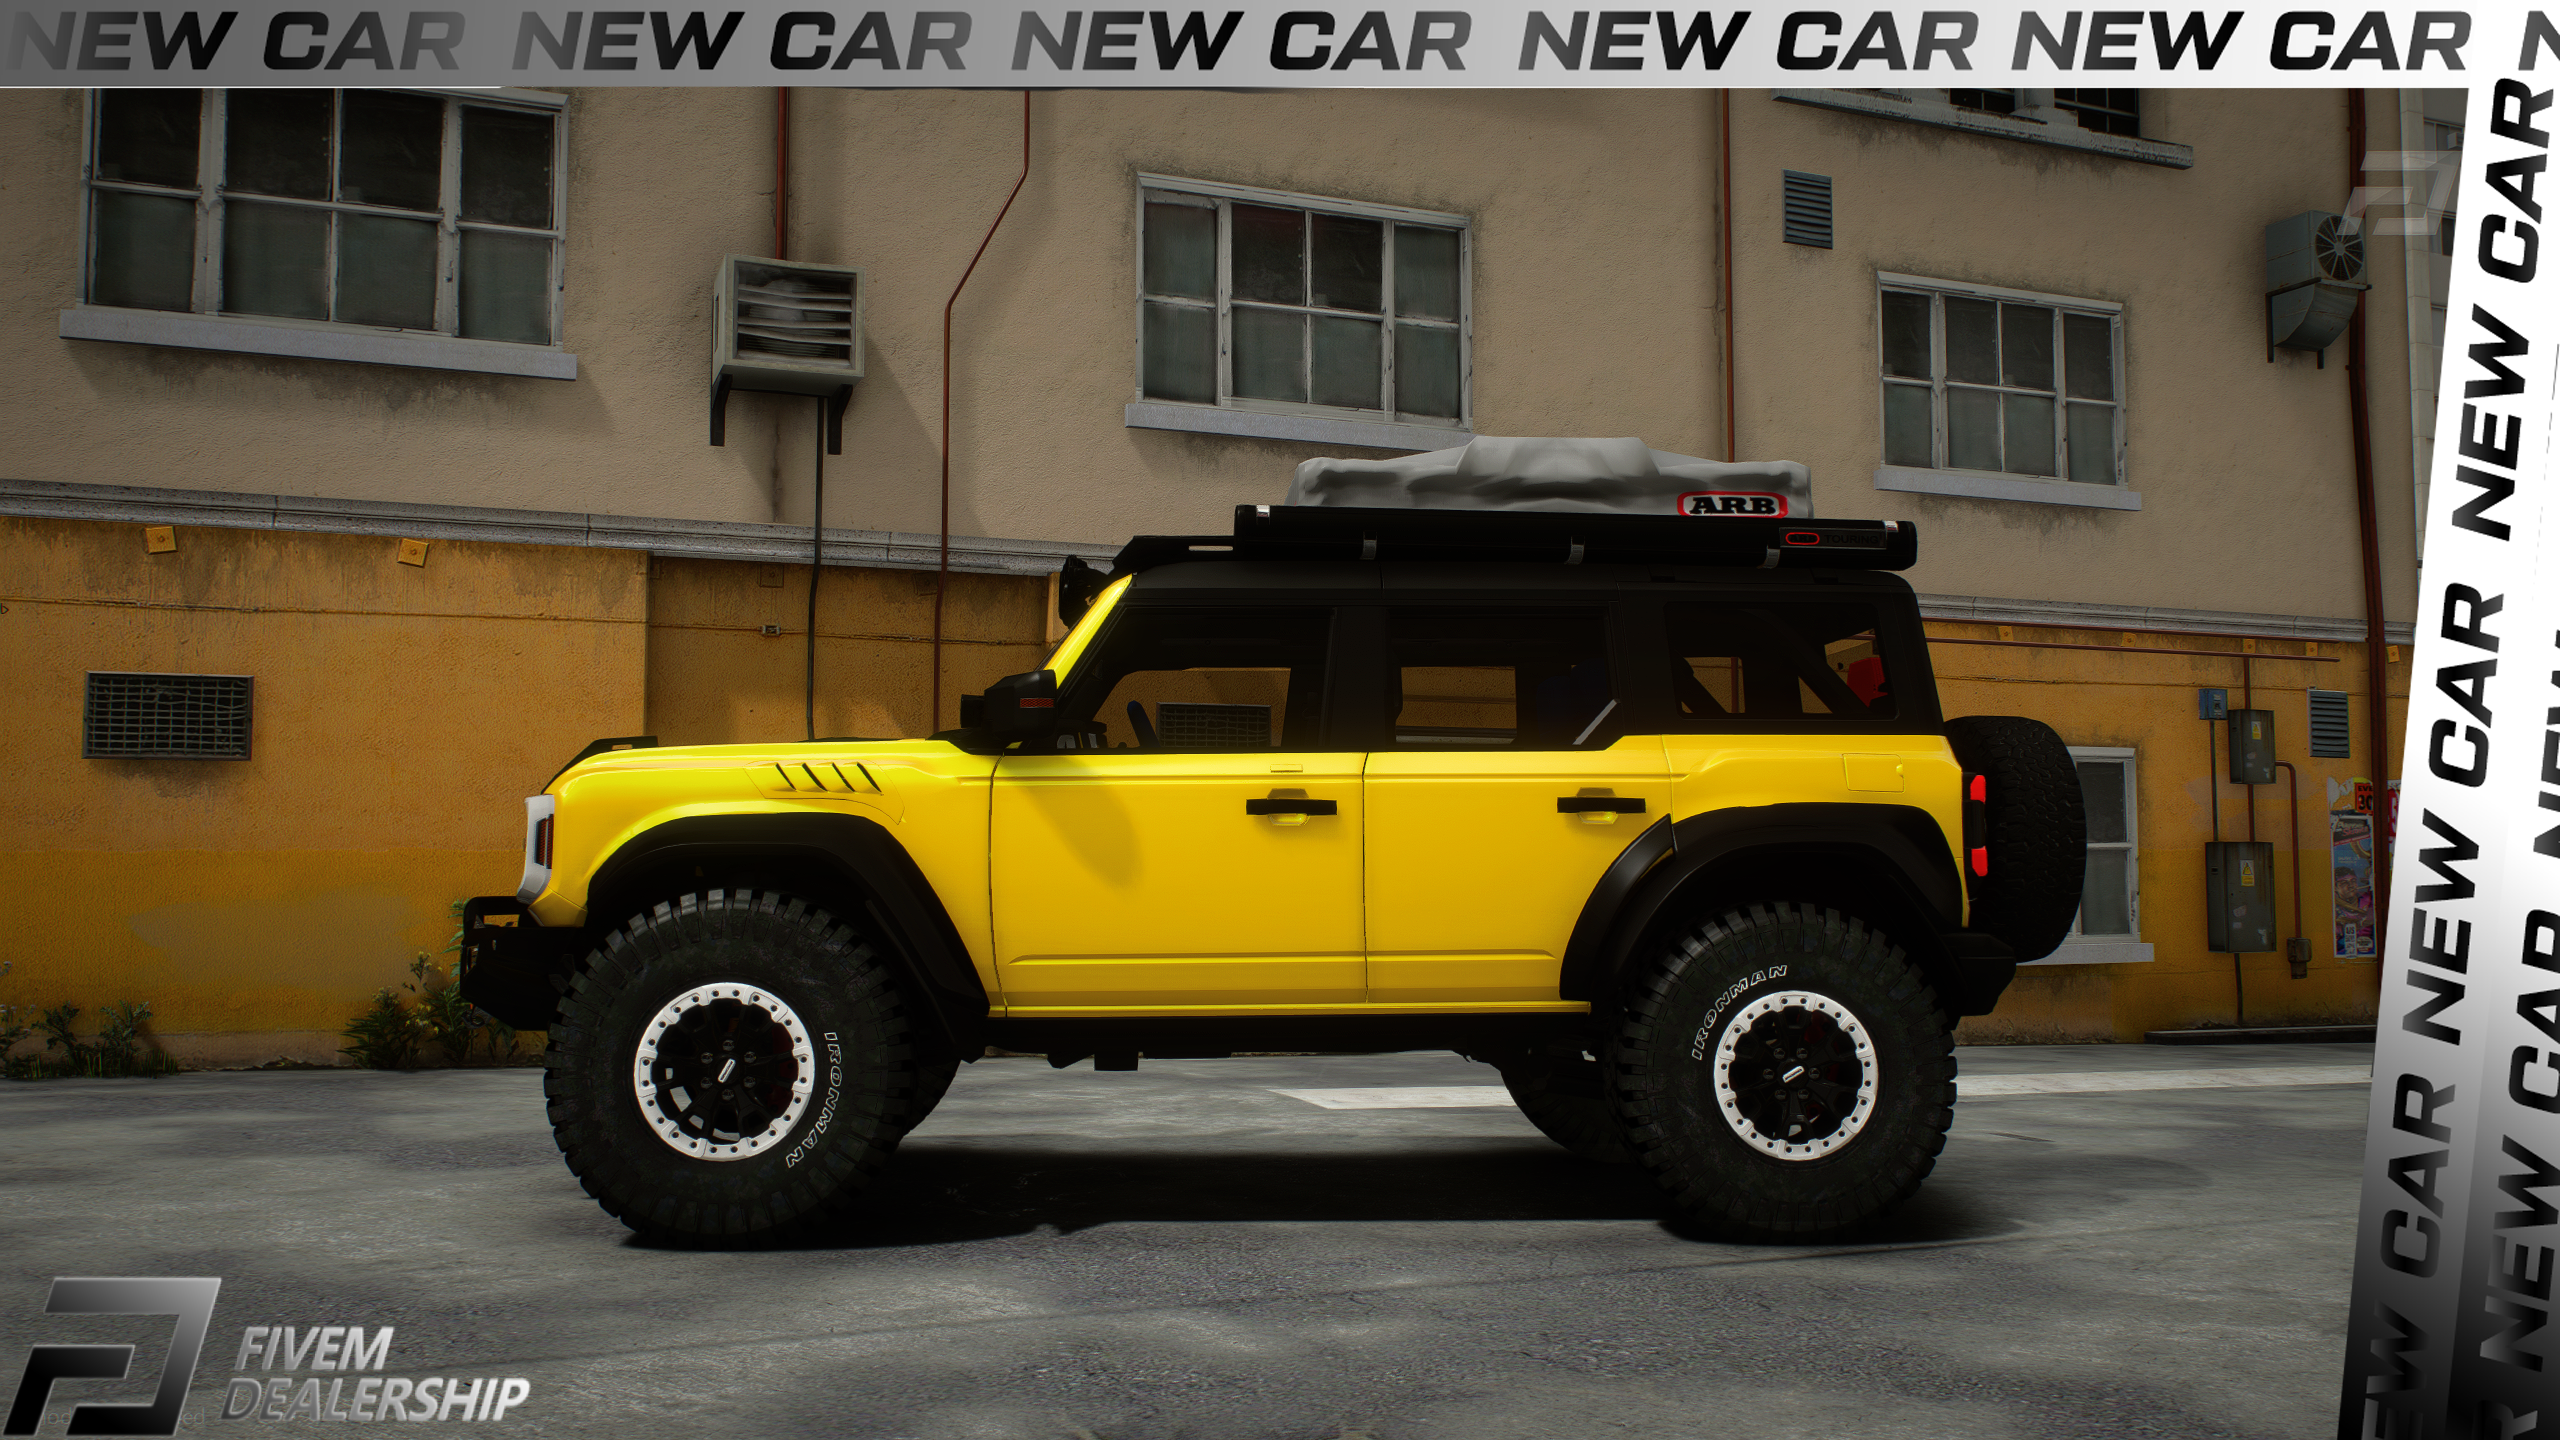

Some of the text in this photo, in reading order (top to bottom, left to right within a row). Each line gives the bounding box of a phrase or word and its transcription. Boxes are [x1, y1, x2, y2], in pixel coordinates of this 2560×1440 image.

[1689, 496, 1777, 515] ARB
[1823, 534, 1879, 544] TOURING
[1690, 964, 1788, 1061] IRONMAN
[785, 1031, 842, 1169] IRONMAN
